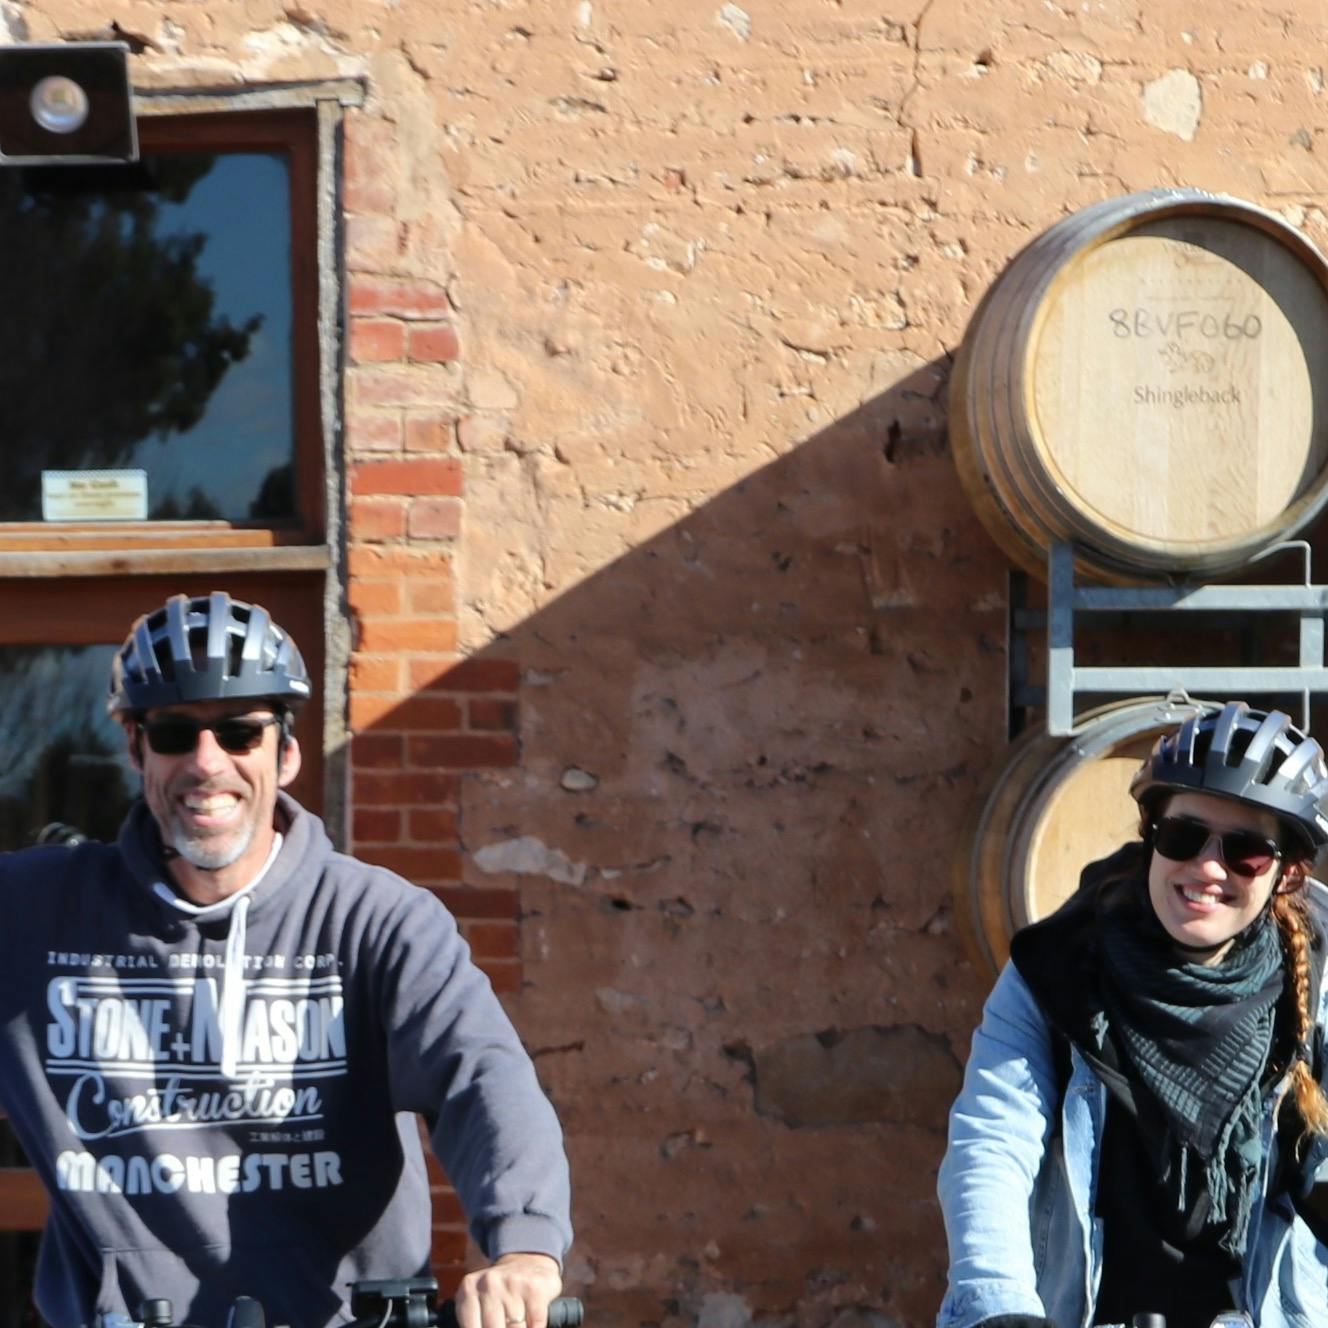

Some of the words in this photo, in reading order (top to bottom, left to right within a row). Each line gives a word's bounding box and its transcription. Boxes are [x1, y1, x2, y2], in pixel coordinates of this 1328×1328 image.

[1109, 307, 1262, 340] 8BVF060
[1133, 384, 1242, 408] Shingleback
[47, 951, 159, 968] INDUSTRIAL
[168, 952, 286, 970] DEMOLTION
[66, 1071, 322, 1141] Construction
[56, 1151, 344, 1195] MANCHESTER
